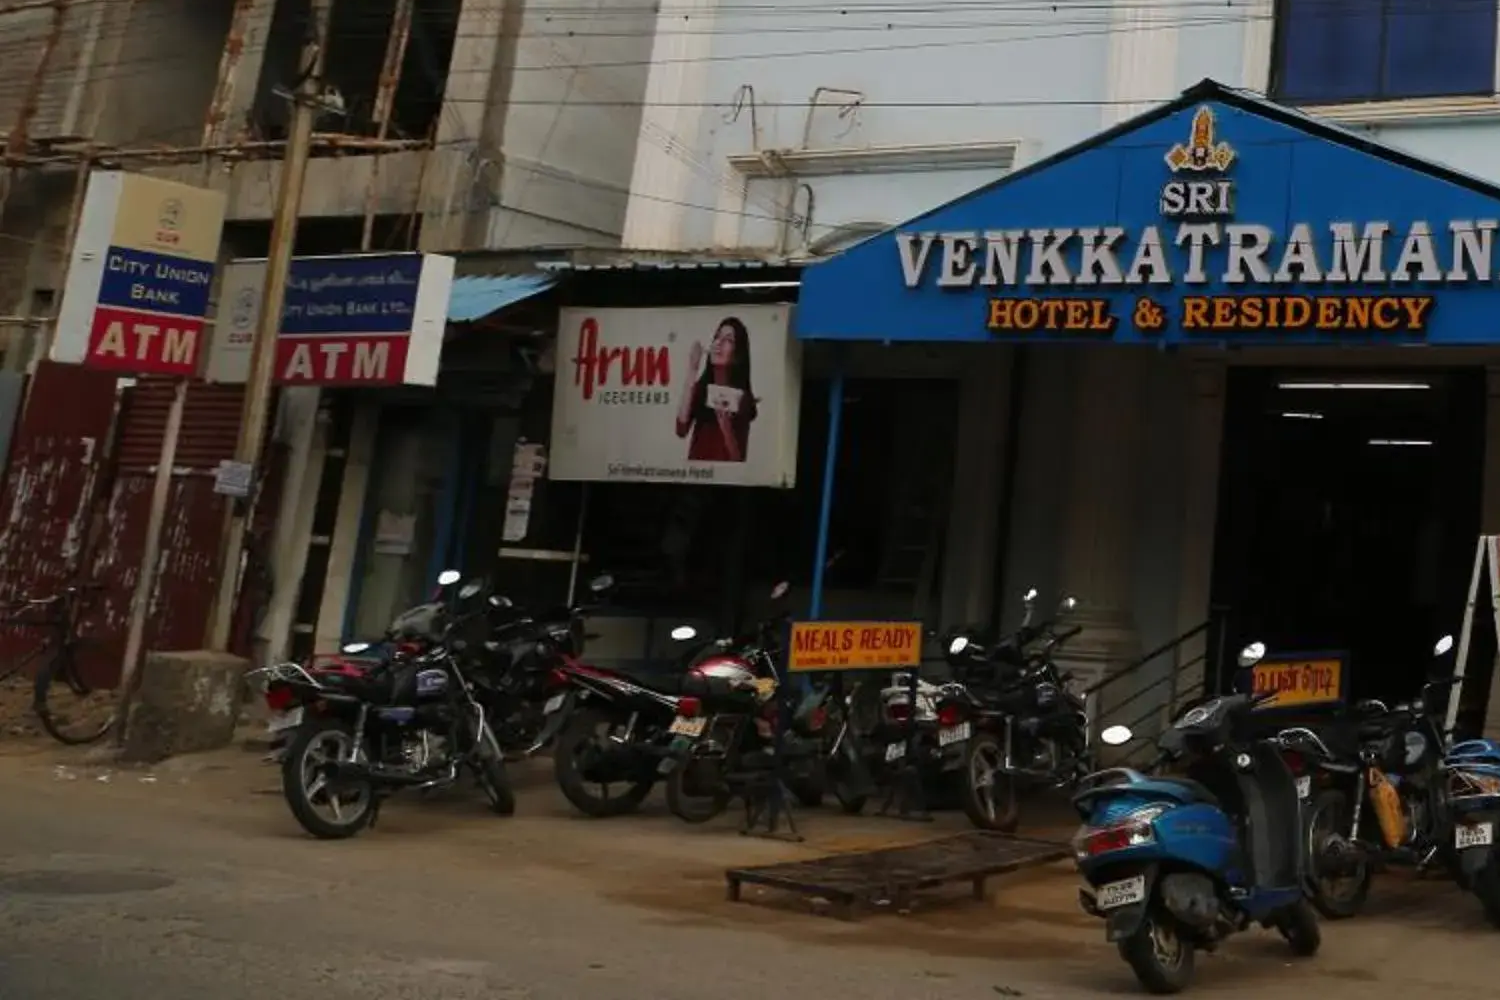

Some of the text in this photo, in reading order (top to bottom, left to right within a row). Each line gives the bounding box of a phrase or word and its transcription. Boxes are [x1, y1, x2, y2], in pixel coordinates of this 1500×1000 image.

[1161, 180, 1232, 214] SRI
[109, 254, 209, 285] CITY UNION
[130, 283, 181, 305] BANK
[988, 296, 1431, 329] HOTEL & RESIDENCY
[95, 320, 198, 365] ATM
[571, 317, 670, 400] Arun
[284, 341, 391, 381] ATM
[796, 625, 915, 652] MEALS READY
